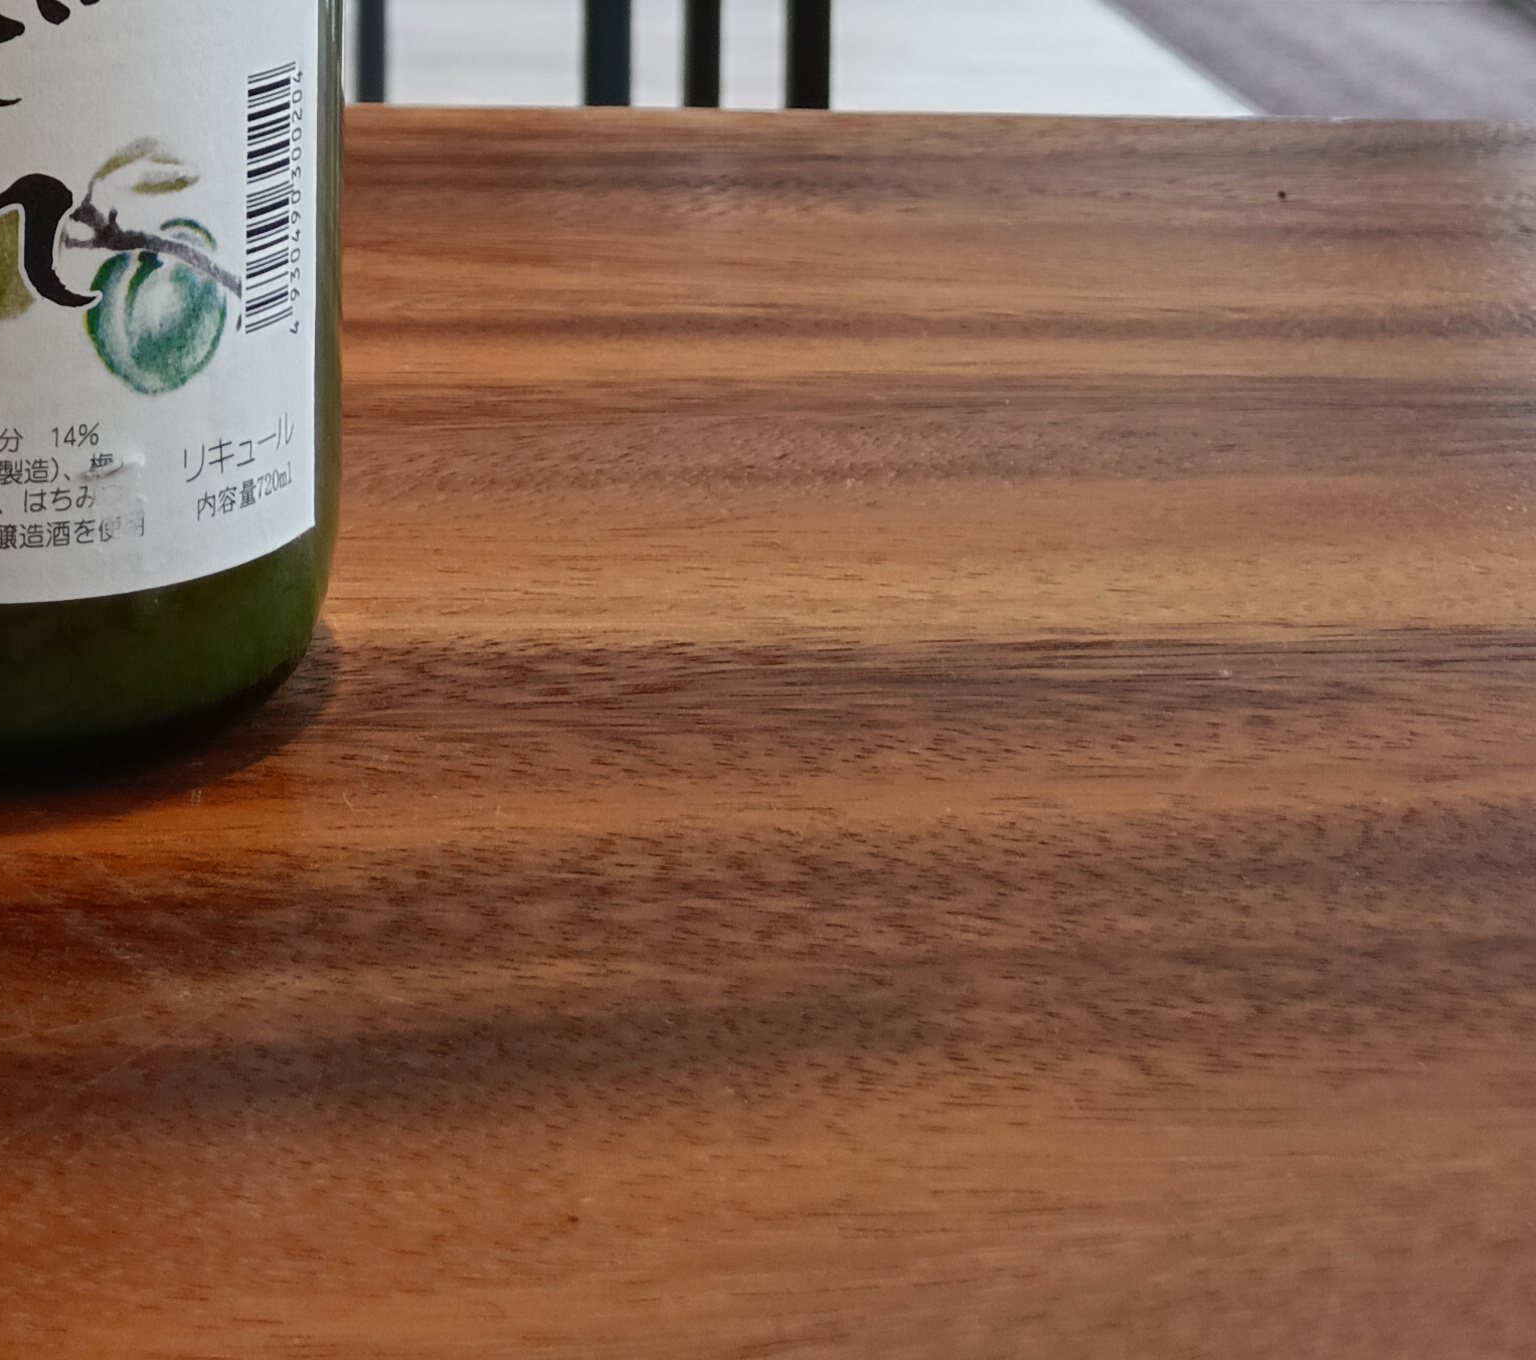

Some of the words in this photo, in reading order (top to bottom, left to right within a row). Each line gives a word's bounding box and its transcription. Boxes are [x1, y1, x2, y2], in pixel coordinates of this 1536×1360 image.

[51, 422, 100, 448] 14%
[183, 411, 295, 484] リキュール
